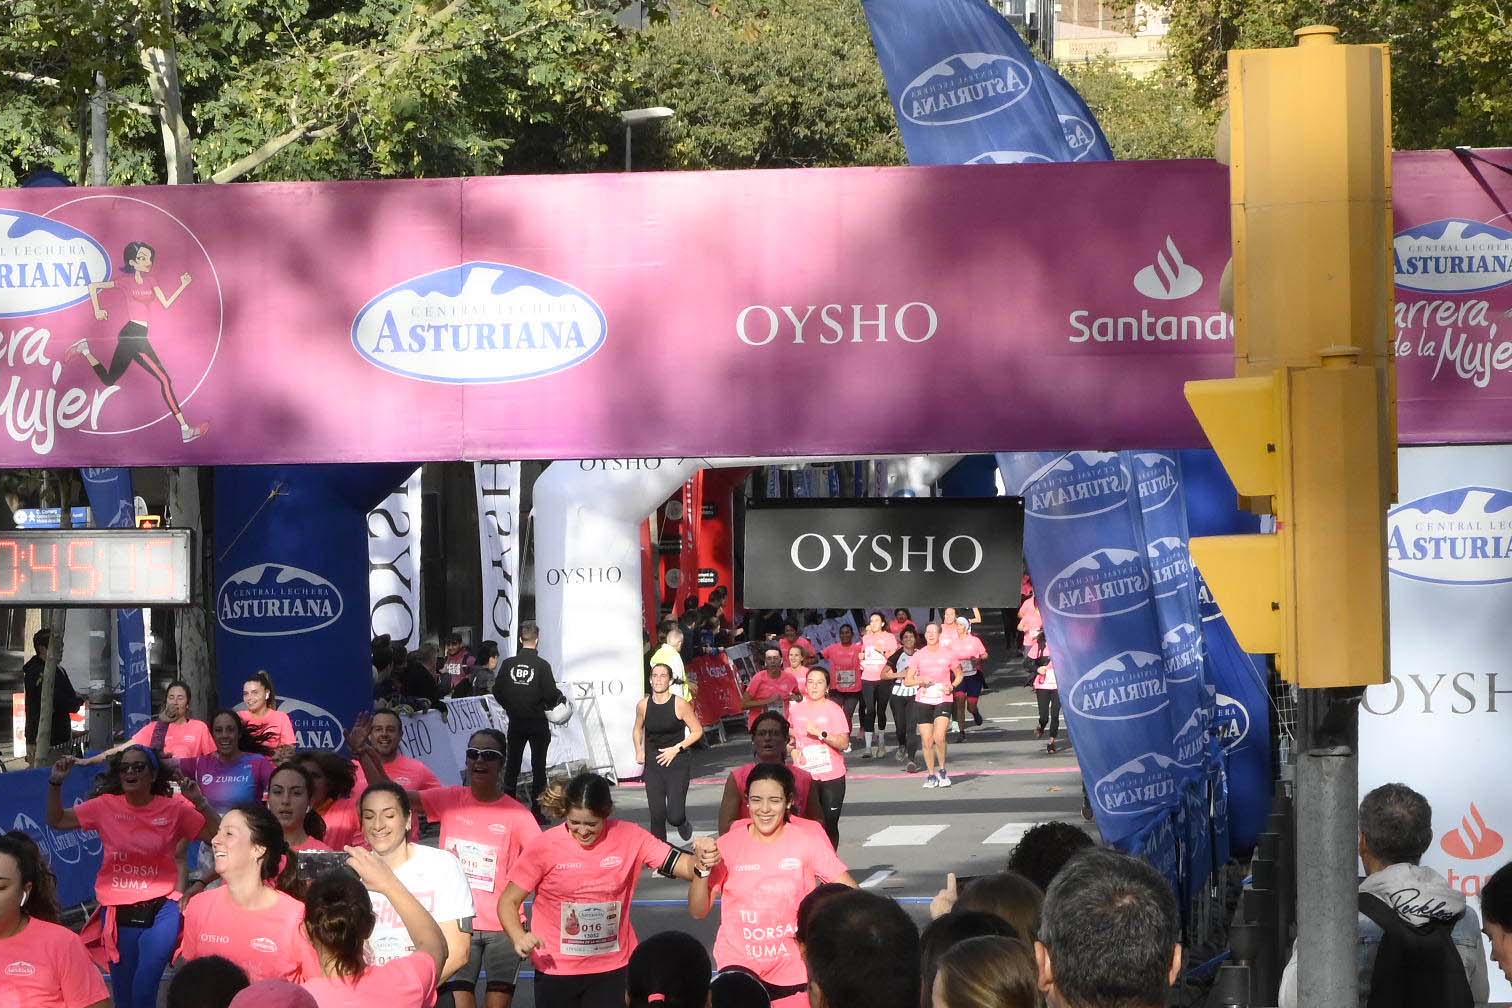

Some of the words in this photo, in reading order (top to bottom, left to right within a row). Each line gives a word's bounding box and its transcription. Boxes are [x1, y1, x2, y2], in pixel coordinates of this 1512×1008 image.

[13, 244, 87, 257] LECHERA
[1408, 243, 1460, 253] CENTRAL
[1465, 243, 1512, 252] LECHER
[411, 303, 488, 317] CENTRAL
[498, 302, 579, 316] LECHERA
[1394, 299, 1490, 328] arrera
[371, 309, 586, 354] ASTURIANA
[735, 302, 939, 346] OYSHO
[1069, 310, 1234, 343] Santand
[1417, 329, 1436, 357] la
[1431, 322, 1512, 388] Muje
[1415, 520, 1477, 531] CENTRAL
[481, 461, 513, 638] OYSH
[1388, 523, 1512, 561] ASTURI
[789, 532, 984, 575] OYSHO
[546, 565, 622, 586] OYSHO
[233, 587, 277, 597] CENTRAL
[279, 587, 330, 597] LECHERA
[221, 590, 334, 620] ASTURIANA
[516, 668, 529, 679] BP
[576, 678, 624, 697] SHO
[1361, 671, 1512, 716] OYSH
[215, 775, 249, 784] ZURICH
[111, 851, 128, 862] TU
[111, 877, 149, 889] SUMA
[741, 909, 757, 923] TU
[581, 923, 602, 932] 016
[743, 925, 798, 941] DORSA
[744, 942, 788, 959] SUMA
